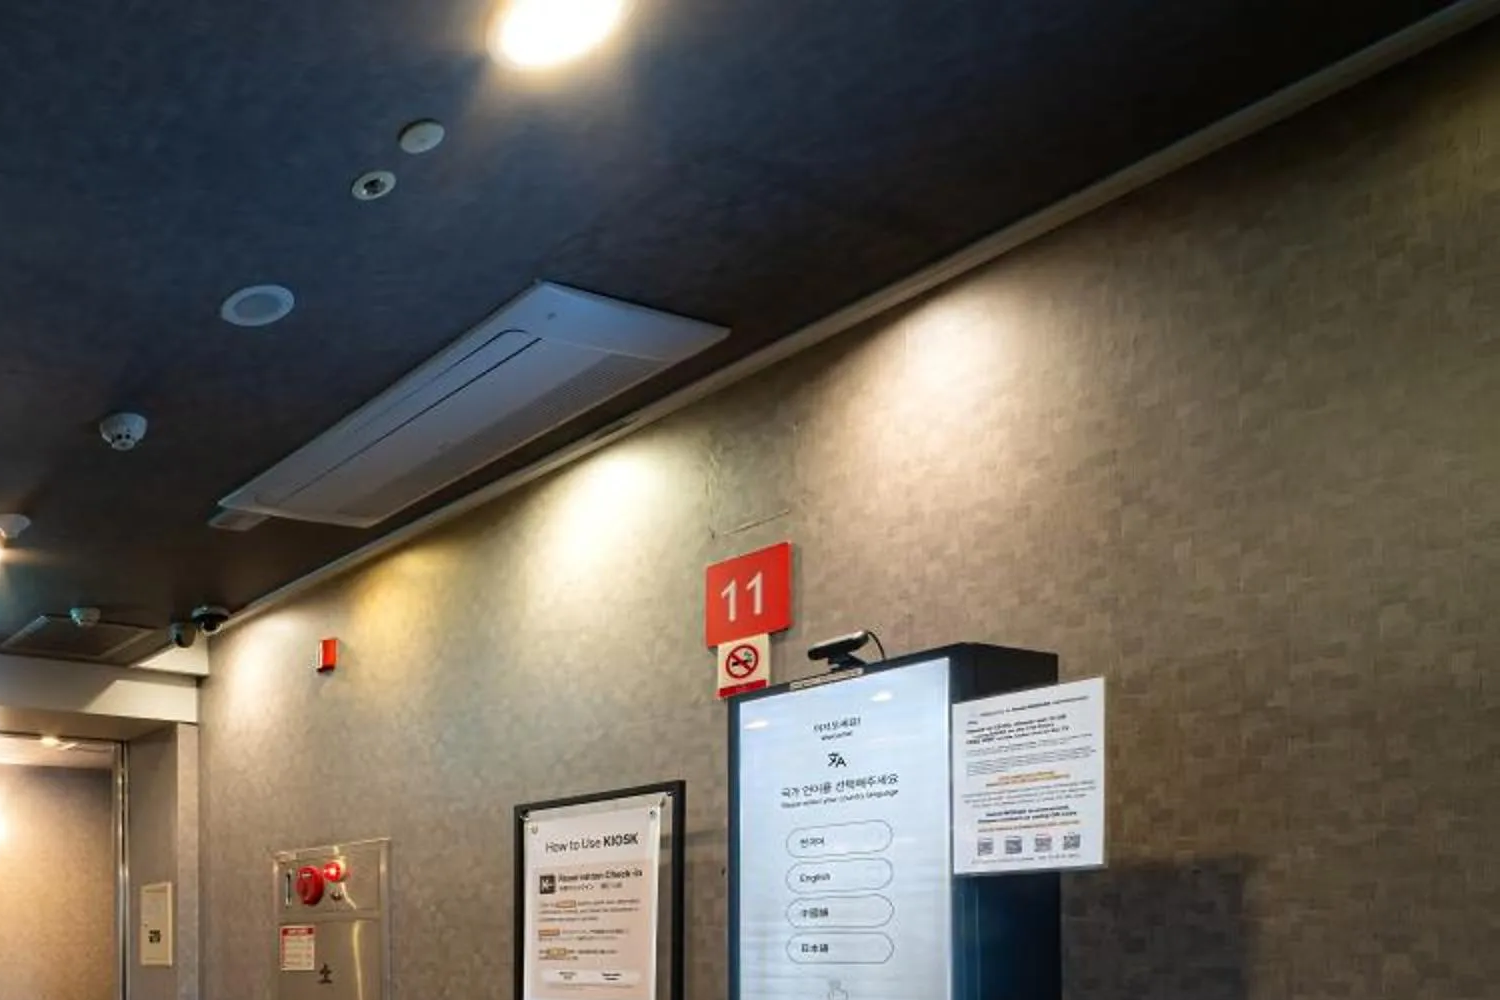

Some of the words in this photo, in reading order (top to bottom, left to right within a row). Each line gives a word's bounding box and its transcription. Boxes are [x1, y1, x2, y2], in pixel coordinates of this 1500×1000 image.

[720, 570, 764, 623] 11
[546, 842, 567, 852] How
[569, 839, 580, 851] to
[581, 837, 602, 849] Use
[603, 832, 639, 847] KIOSK
[799, 872, 831, 884] English
